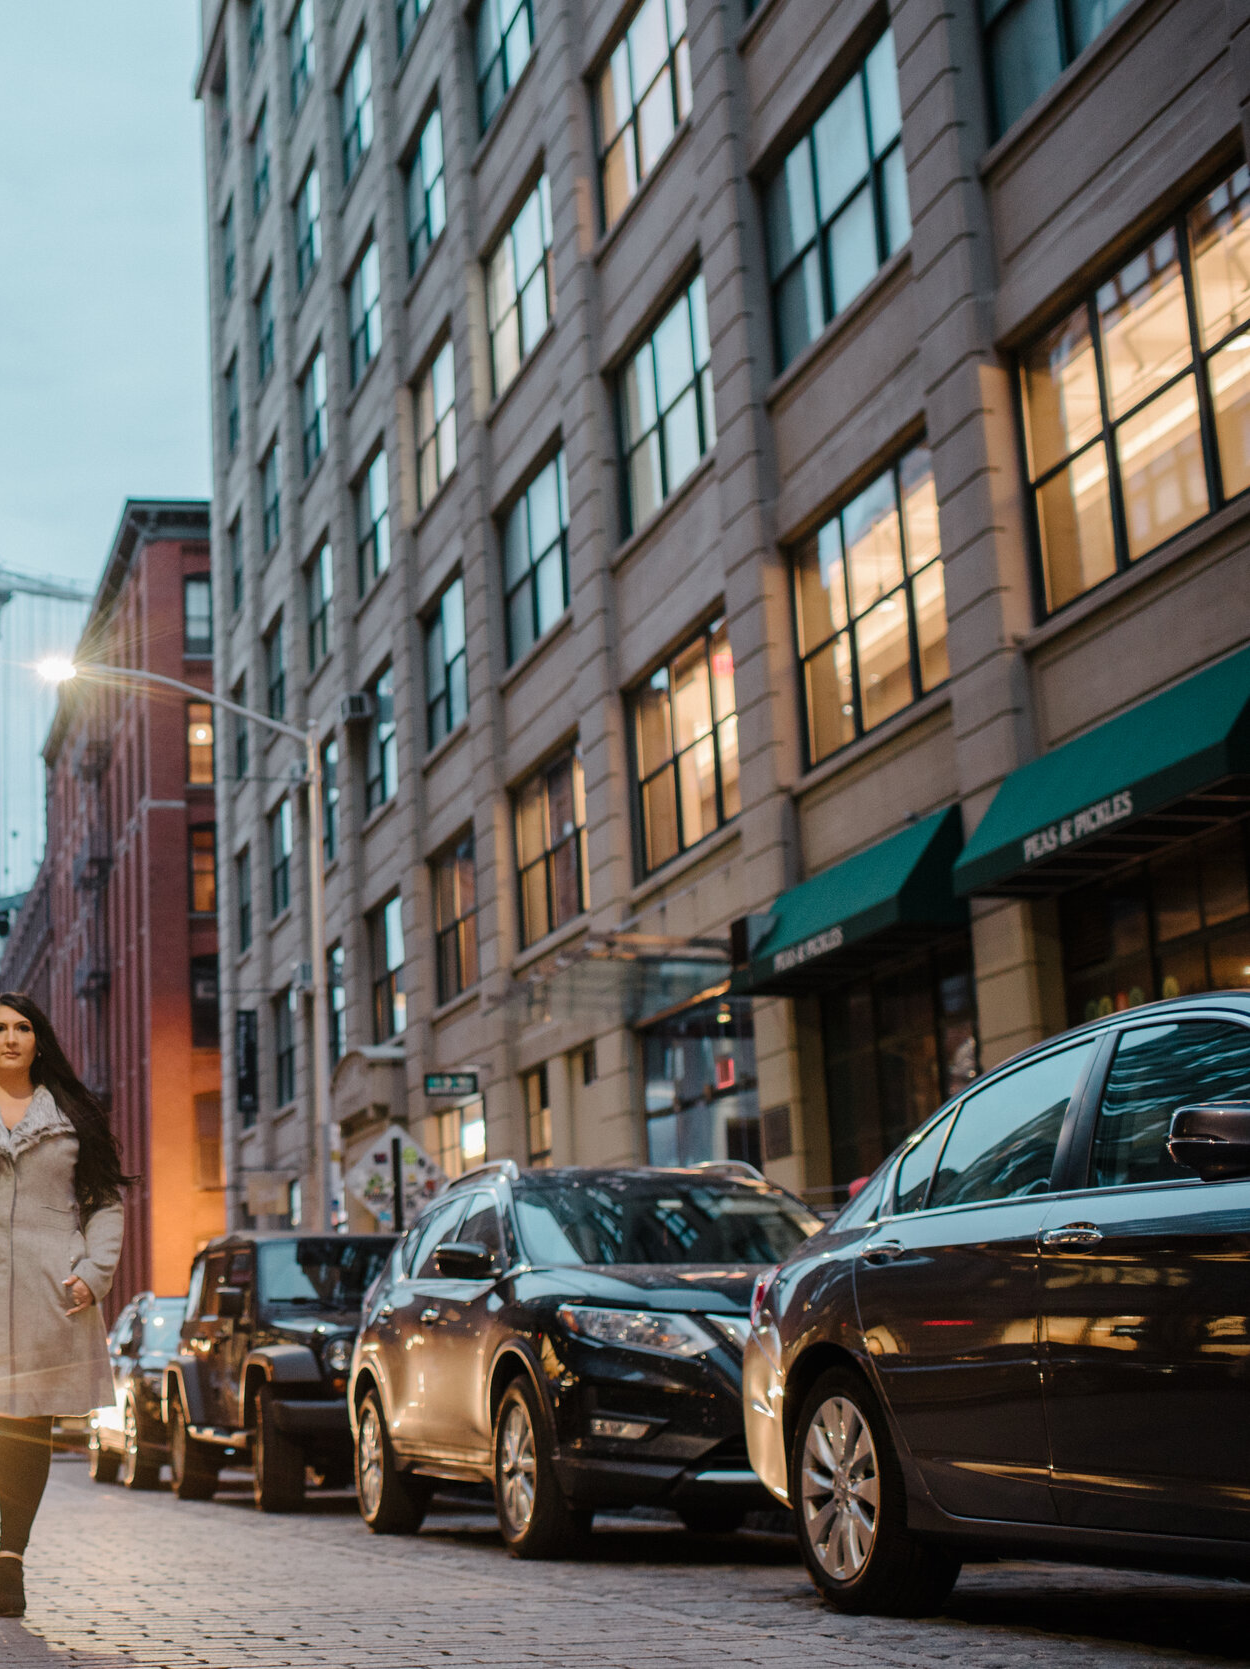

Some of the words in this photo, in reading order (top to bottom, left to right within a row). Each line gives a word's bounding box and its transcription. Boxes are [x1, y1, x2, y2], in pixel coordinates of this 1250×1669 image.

[1024, 826, 1058, 862] PEAS
[1060, 819, 1073, 845] &
[1074, 790, 1132, 838] PICKLES
